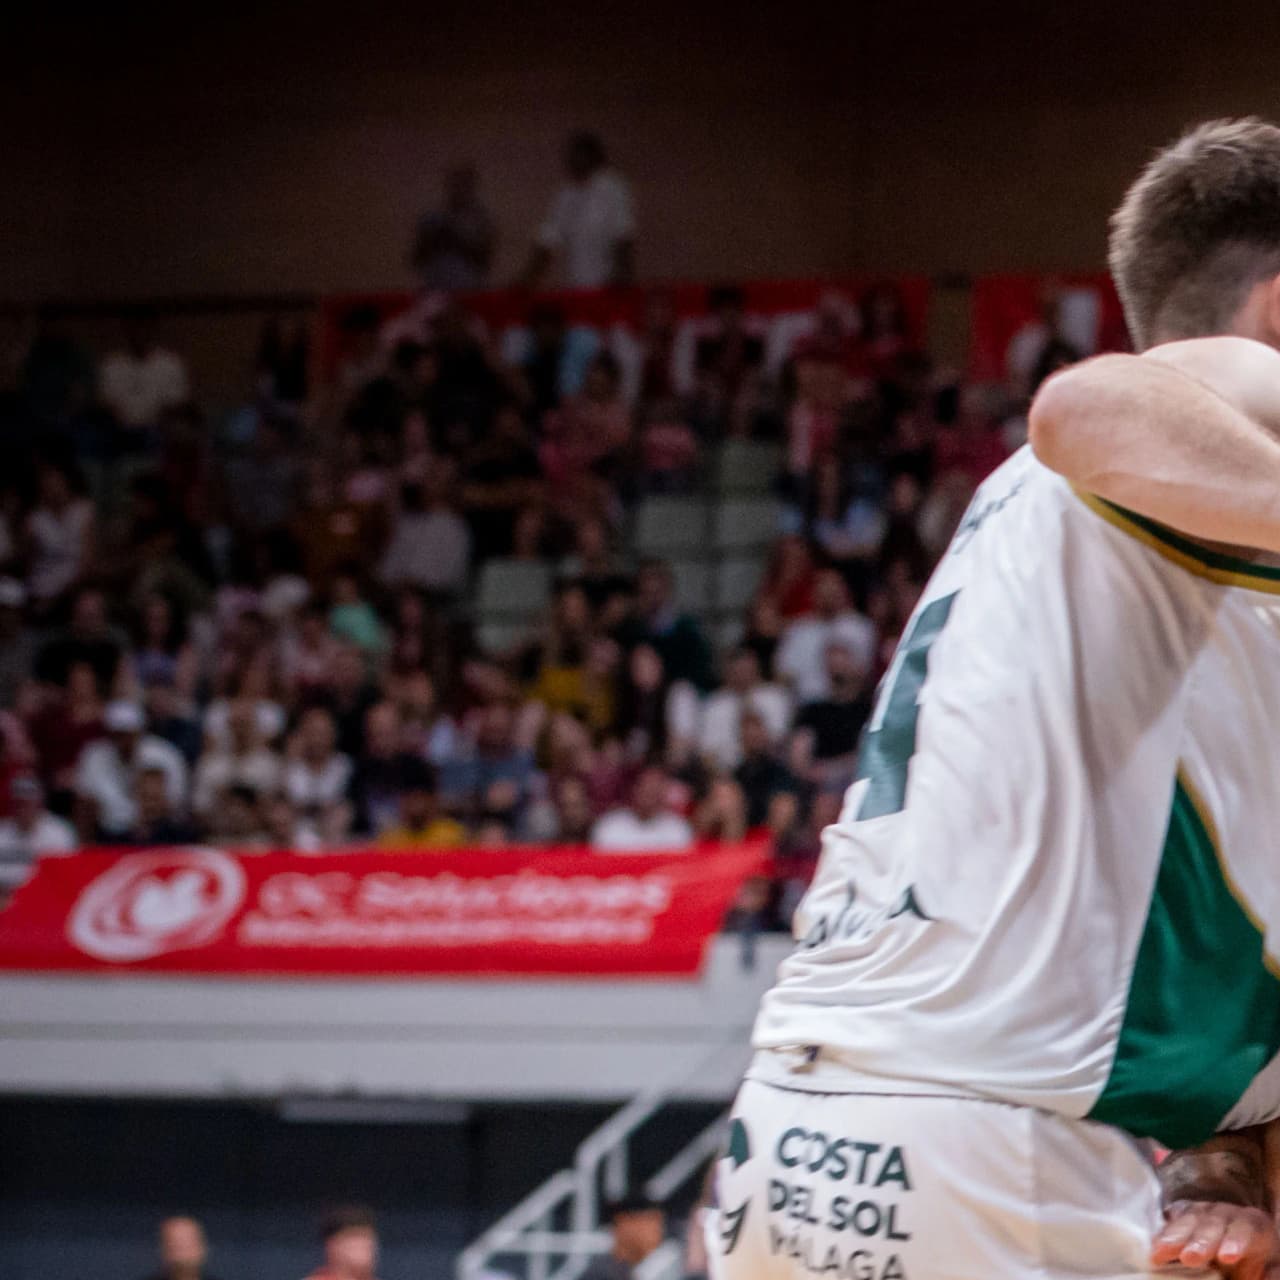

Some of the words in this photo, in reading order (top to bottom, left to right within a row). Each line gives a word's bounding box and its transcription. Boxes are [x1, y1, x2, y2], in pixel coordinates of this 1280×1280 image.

[777, 1127, 914, 1191] COSTA
[769, 1179, 820, 1224] DEL
[827, 1196, 912, 1242] SOL
